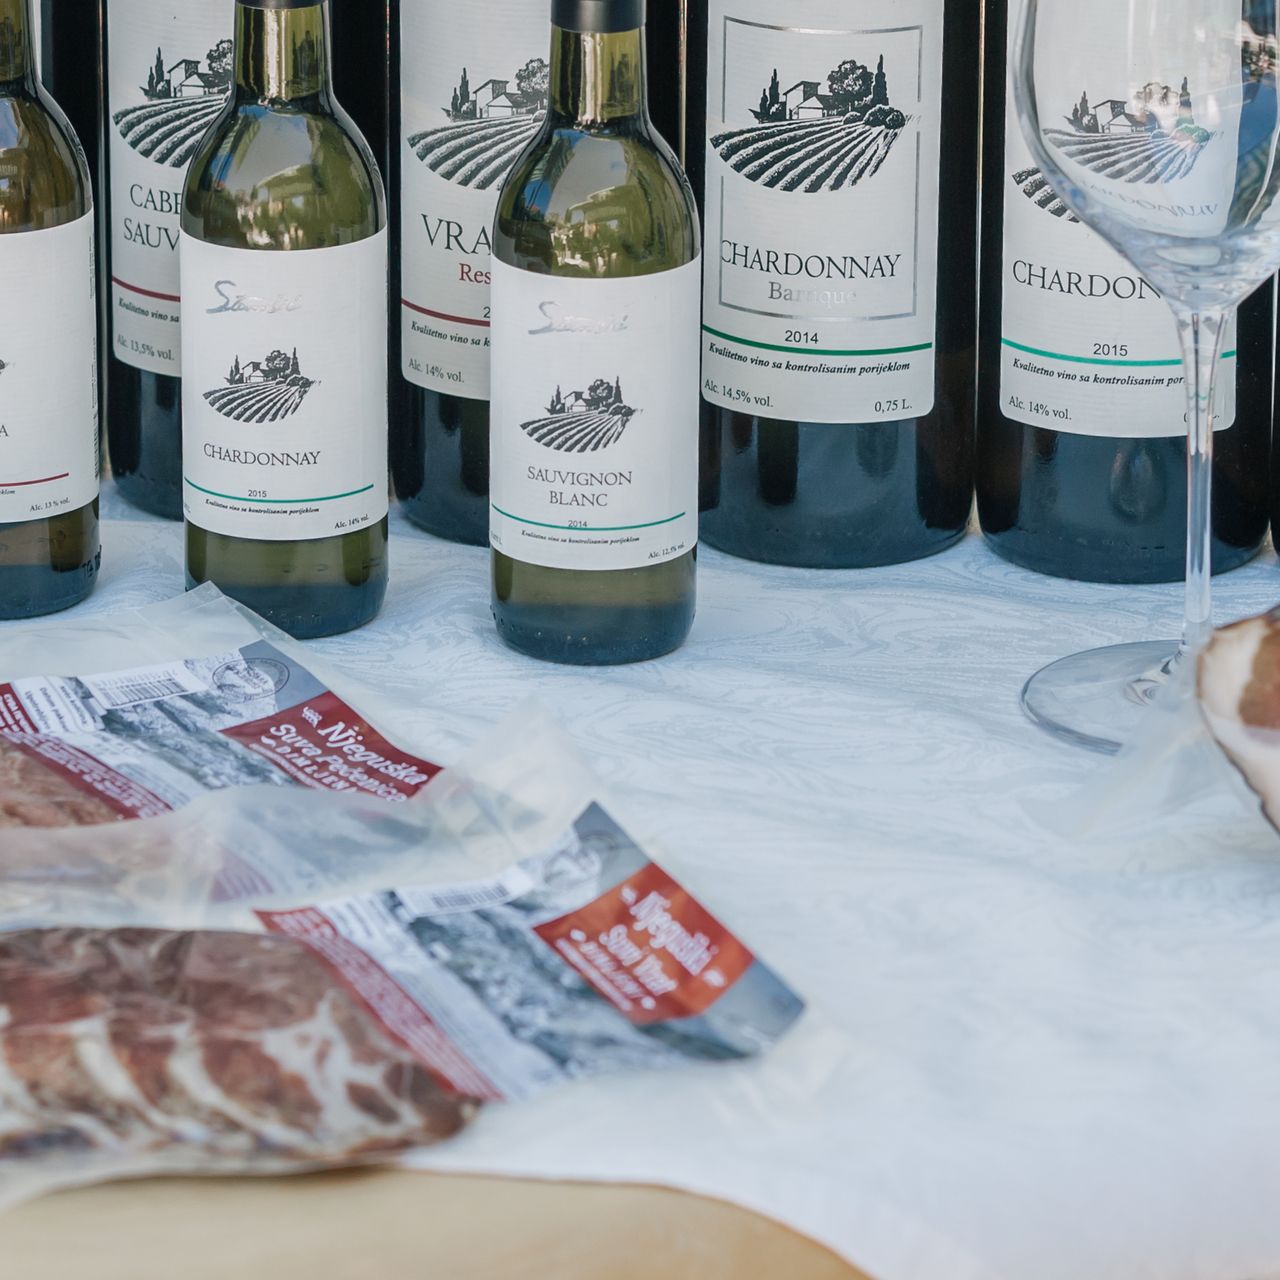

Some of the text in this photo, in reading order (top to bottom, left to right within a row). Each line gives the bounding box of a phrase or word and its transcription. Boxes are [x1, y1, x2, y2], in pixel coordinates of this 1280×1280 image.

[123, 217, 180, 251] SAUV
[421, 213, 491, 256] VRA
[721, 240, 901, 280] CHARDONNAY
[459, 262, 491, 284] Res
[1012, 260, 1161, 299] CHARDON
[151, 310, 168, 322] vino
[170, 315, 180, 323] sa
[411, 321, 447, 340] Kvalitetno
[449, 334, 468, 344] vino
[785, 330, 819, 344] 2014
[130, 336, 155, 357] 13,5%
[157, 349, 175, 361] vol.
[709, 342, 910, 376] Kvalitetno vino sa kontrolisanim porijeklom
[1093, 343, 1128, 357] 2015
[408, 357, 464, 383] Alc. 14% vol.
[1013, 358, 1185, 388] Kvalitetno vino sa kontrolisanim por
[704, 379, 774, 408] Alc. 14,5% vol.
[874, 398, 913, 413] 0,75 L.
[1009, 396, 1072, 420] Alc. 14% vol.
[204, 443, 320, 466] CHARDONNAY
[527, 466, 633, 486] SAUVIGNON
[248, 489, 267, 498] 2015
[549, 490, 608, 507] BLANC
[29, 504, 43, 512] Alc.
[248, 506, 288, 514] kontrolisanim
[289, 506, 320, 515] porijeklom
[334, 521, 347, 529] Alc.
[568, 520, 587, 528] 2014
[568, 536, 609, 544] kontrolisanim
[609, 536, 640, 545] porijeklom
[648, 551, 661, 559] Alc.
[270, 724, 322, 756] Suva
[318, 721, 428, 785] Njeguška
